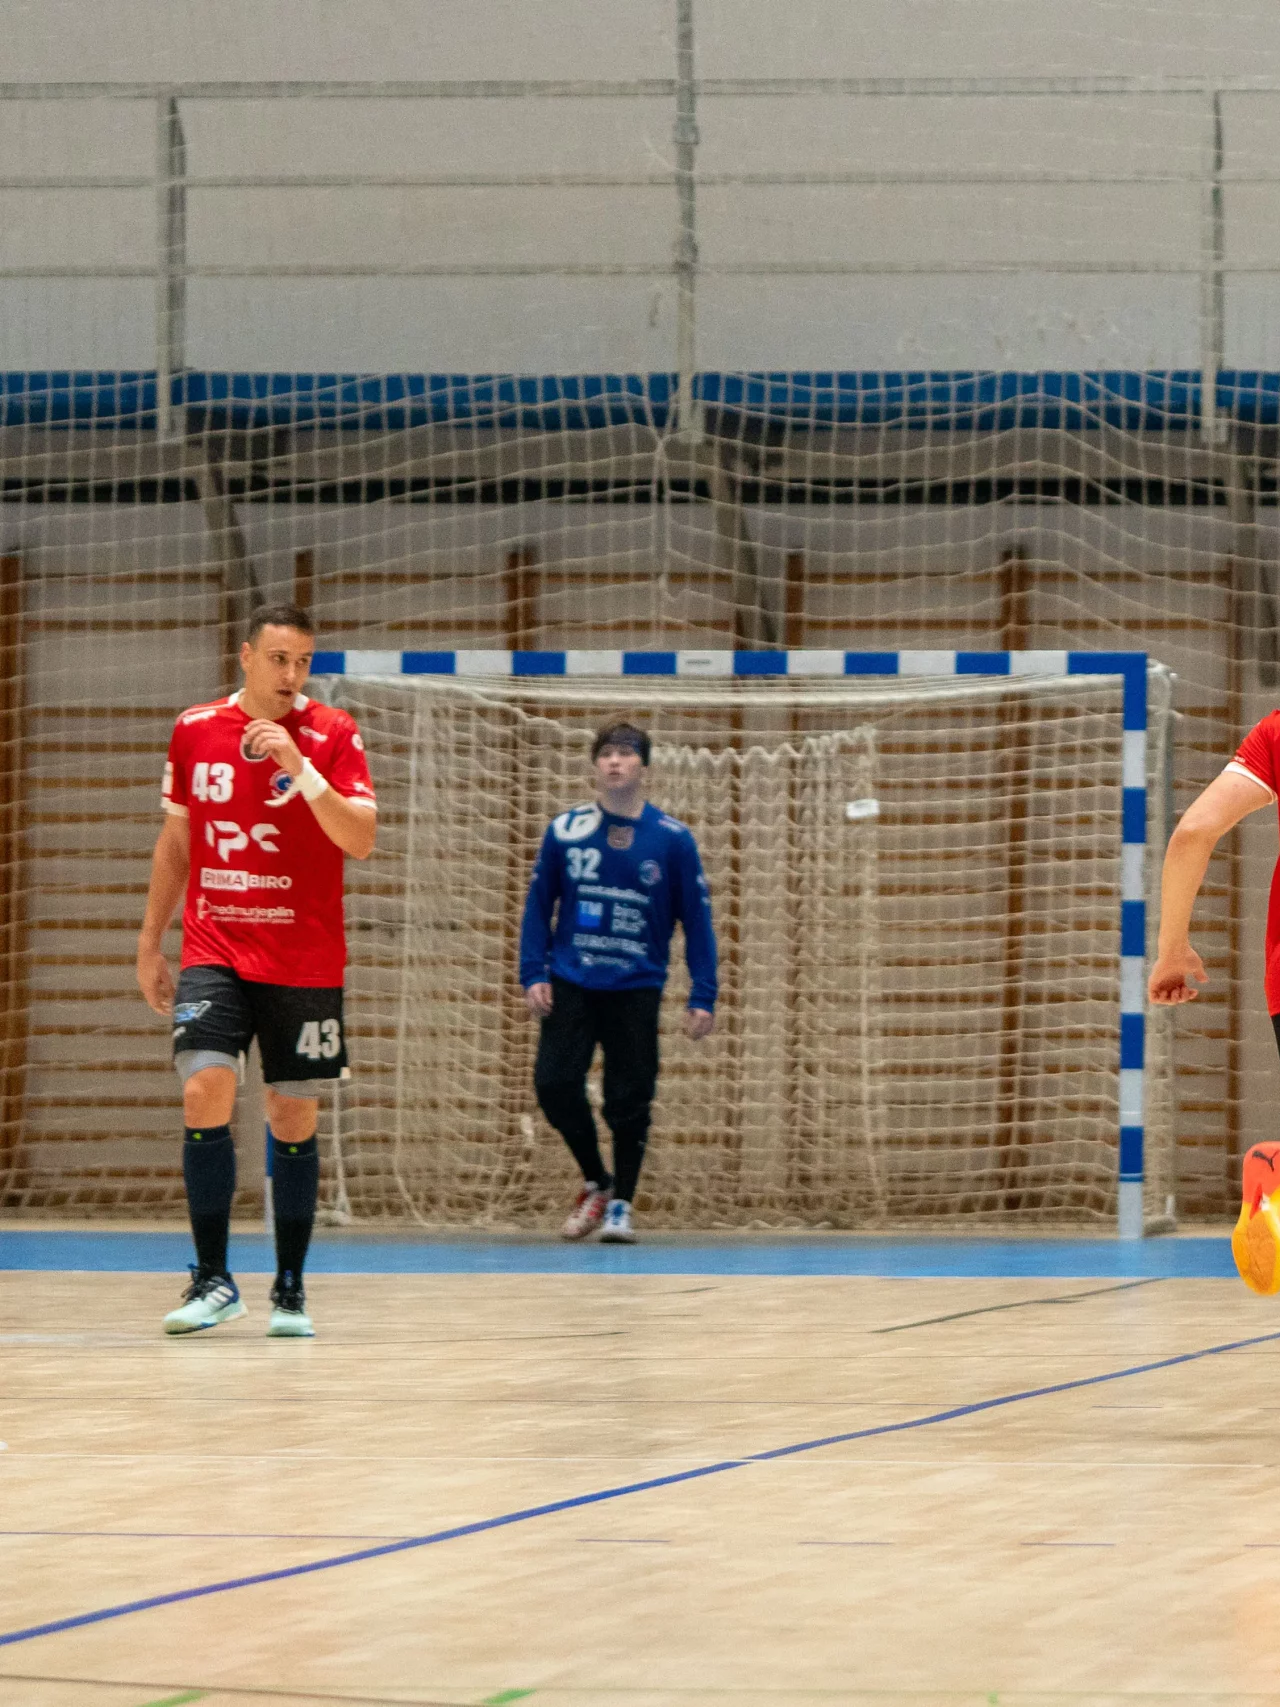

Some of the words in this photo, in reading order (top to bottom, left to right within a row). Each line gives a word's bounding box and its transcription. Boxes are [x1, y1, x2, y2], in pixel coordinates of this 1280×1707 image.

[191, 762, 235, 803] 43
[566, 847, 602, 881] 32
[296, 1019, 342, 1060] 43
